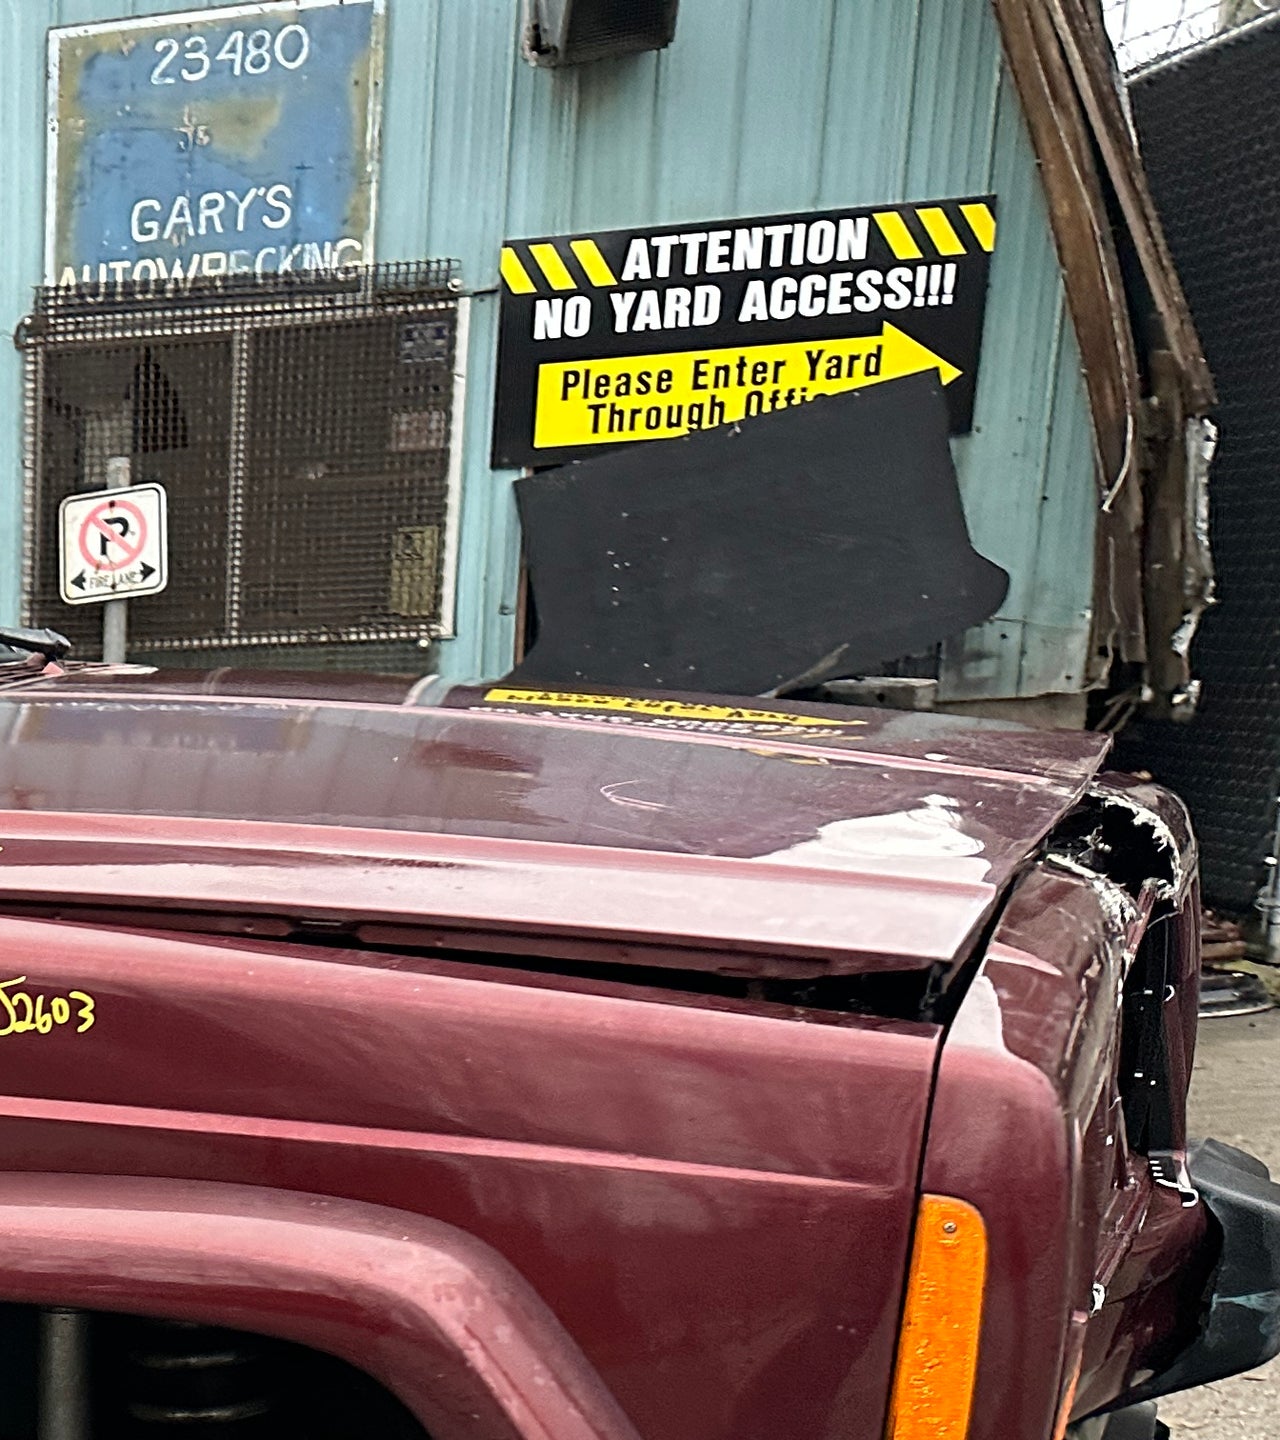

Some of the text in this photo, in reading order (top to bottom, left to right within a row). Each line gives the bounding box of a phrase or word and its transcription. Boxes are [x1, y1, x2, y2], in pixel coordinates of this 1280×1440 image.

[150, 24, 309, 85] 23480
[130, 184, 293, 243] GARY'S
[620, 217, 870, 282] ATTENTION
[533, 262, 958, 341] NO YARD ACCESS!!!
[561, 344, 884, 401] Please Enter Yard
[587, 394, 726, 434] Through
